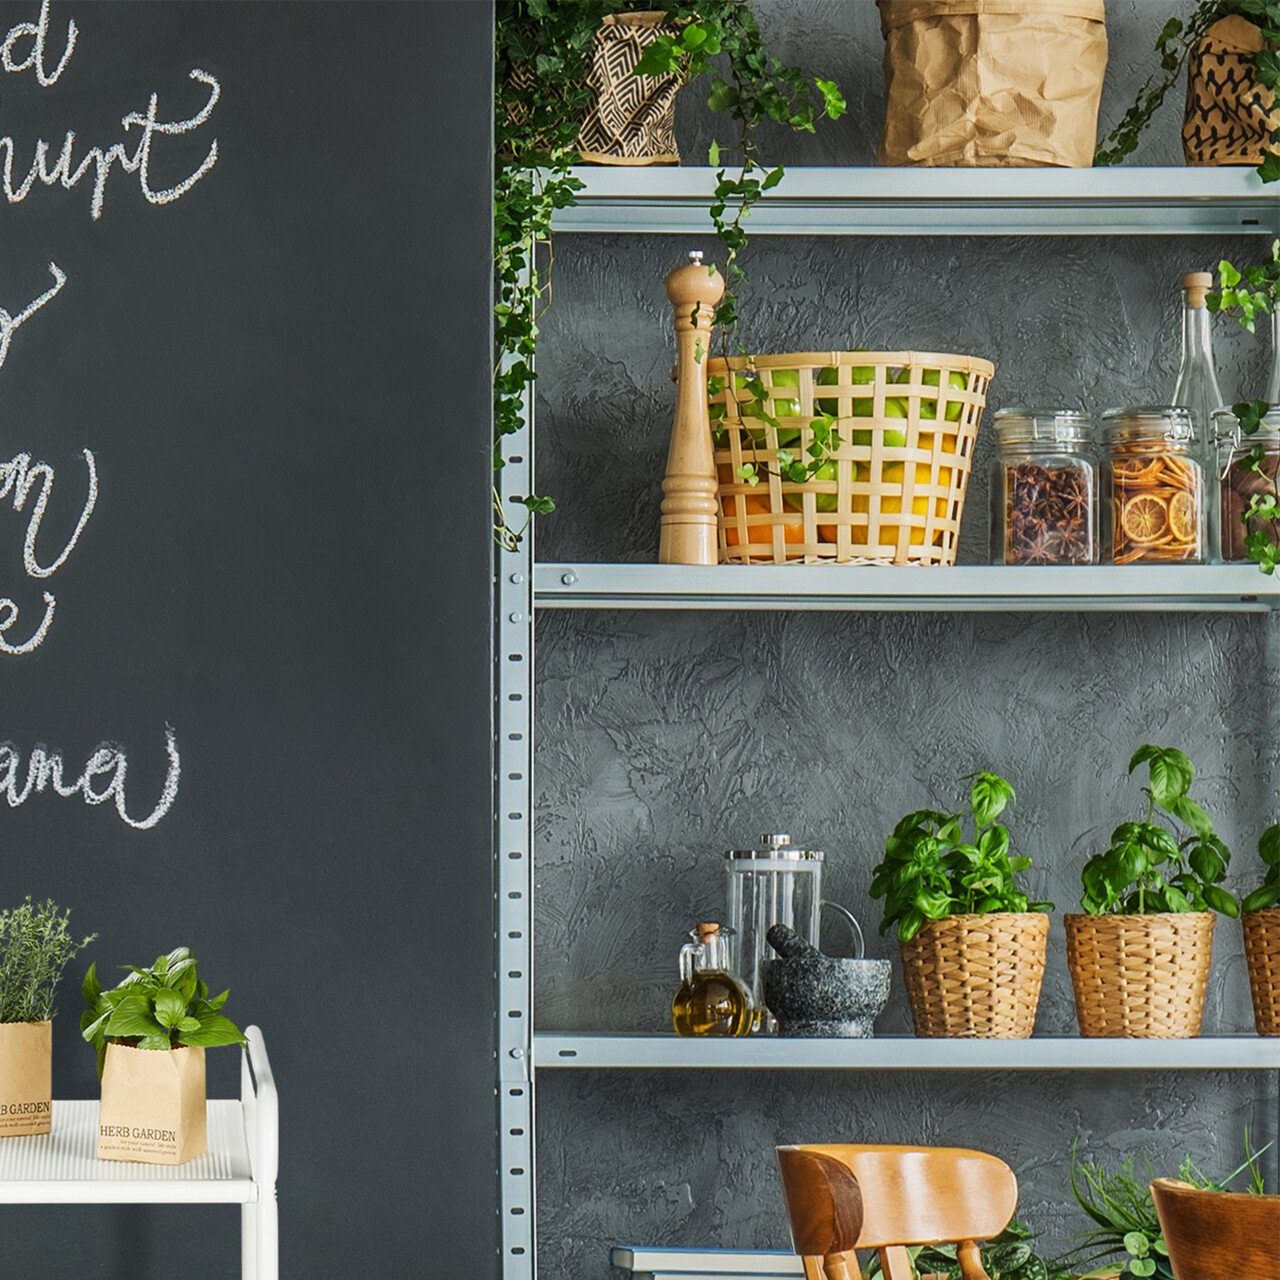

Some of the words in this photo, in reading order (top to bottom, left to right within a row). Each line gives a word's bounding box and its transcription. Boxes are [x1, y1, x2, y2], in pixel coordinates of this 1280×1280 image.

[9, 1101, 50, 1115] GARDEN
[100, 1125, 130, 1138] HERB
[132, 1127, 176, 1142] GARDEN
